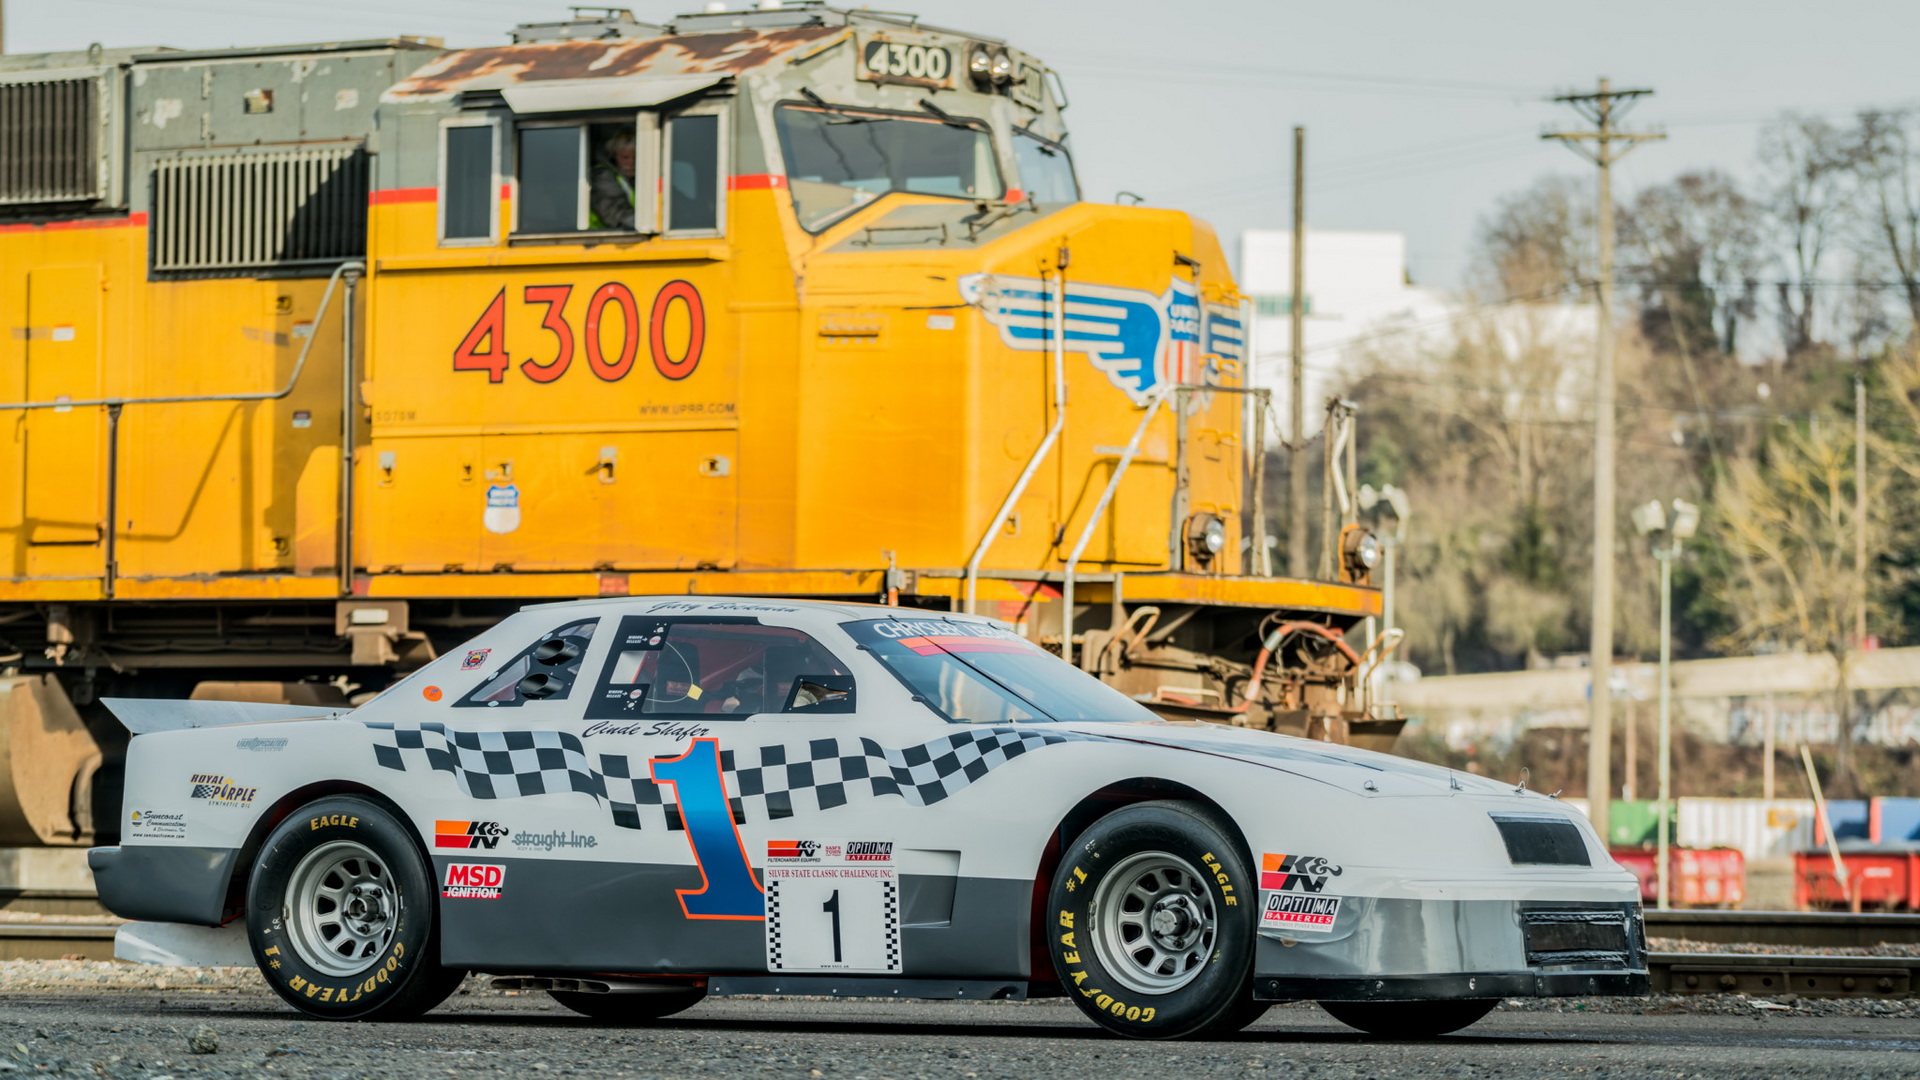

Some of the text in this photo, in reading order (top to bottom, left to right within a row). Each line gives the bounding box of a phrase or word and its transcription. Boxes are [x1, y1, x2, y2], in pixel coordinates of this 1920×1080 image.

[868, 44, 948, 79] 4300
[453, 279, 706, 384] 4300
[873, 621, 968, 638] CHRYSLER
[582, 721, 710, 742] Cinde Shafer
[190, 774, 224, 784] ROYAL
[211, 783, 257, 801] PURPLE
[143, 810, 184, 820] Suncoast
[310, 814, 359, 831] EAGLE
[466, 821, 509, 849] K&N
[649, 737, 766, 921] 1
[846, 842, 893, 855] OPTIMA
[448, 865, 502, 887] MSD
[768, 869, 894, 878] SILVER STATE CLASSIC CHALLENGE INC.
[1201, 852, 1237, 907] EAGLE
[1278, 854, 1343, 893] K&N
[447, 887, 499, 899] IGNITION
[1268, 894, 1339, 915] OPTIMA
[823, 889, 842, 962] 1
[1264, 911, 1334, 925] BATTERIES
[1060, 866, 1156, 1022] GOODYEAR #1
[264, 942, 404, 1003] GOODYEAR #1
